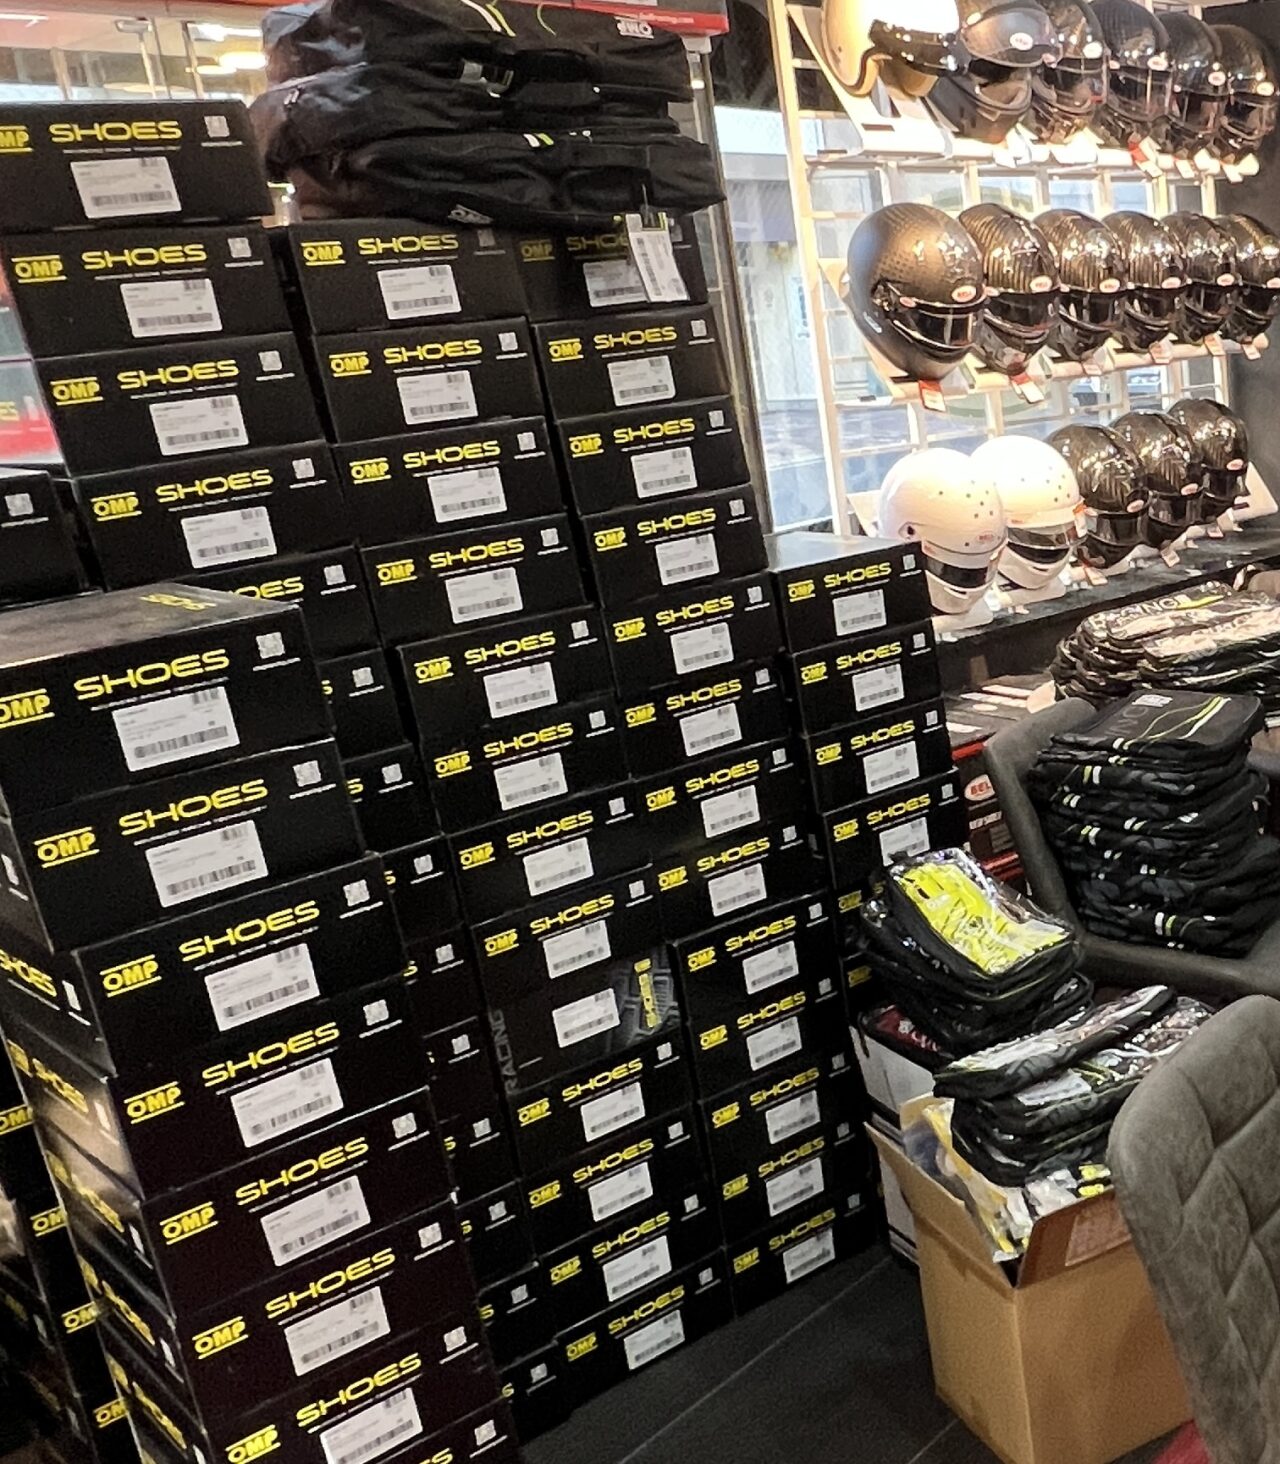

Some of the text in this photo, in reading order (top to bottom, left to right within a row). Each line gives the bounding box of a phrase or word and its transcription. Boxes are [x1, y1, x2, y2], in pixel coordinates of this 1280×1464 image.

[49, 120, 182, 143] SHOES
[303, 244, 343, 263] OMP
[358, 234, 458, 255] SHOES
[566, 235, 630, 251] SHO
[14, 259, 64, 280] OMP
[82, 244, 208, 270] SHOES
[383, 339, 482, 364] SHOES
[550, 340, 582, 359] OMP
[594, 326, 677, 350] SHOES
[117, 360, 240, 390] SHOES
[330, 354, 369, 374] OMP
[53, 380, 100, 402] OMP
[614, 418, 695, 443] SHOES
[403, 441, 500, 468] SHOES
[570, 435, 602, 454] OMP
[351, 461, 388, 481] OMP
[155, 470, 272, 503] SHOES
[94, 495, 139, 518] OMP
[639, 508, 716, 536] SHOES
[596, 529, 626, 548] OMP
[429, 538, 524, 568] SHOES
[377, 562, 415, 583] OMP
[824, 562, 892, 588] SHOES
[229, 576, 304, 600] OES
[788, 582, 814, 600] OMP
[656, 596, 734, 624] SHOES
[614, 620, 645, 639] OMP
[466, 632, 556, 663] SHOES
[837, 643, 900, 670] SHOES
[74, 652, 230, 700] SHOES
[416, 660, 452, 681] OMP
[801, 665, 826, 683] OMP
[666, 680, 742, 710] SHOES
[627, 706, 655, 724] OMP
[484, 723, 573, 757] SHOES
[851, 720, 914, 749] SHOES
[436, 755, 470, 775] OMP
[685, 760, 760, 792] SHOES
[647, 789, 675, 808] OMP
[970, 782, 991, 796] BEL
[119, 780, 268, 836] SHOES
[868, 794, 930, 824] SHOES
[507, 812, 593, 847] SHOES
[36, 832, 96, 863] OMP
[460, 846, 494, 866] OMP
[697, 838, 770, 872] SHOES
[530, 895, 614, 934] SHOES
[180, 902, 320, 962] SHOES
[486, 933, 518, 953] OMP
[725, 916, 796, 951] SHOES
[103, 960, 159, 992] OMP
[738, 992, 806, 1029] SHOES
[202, 1024, 338, 1086] SHOES
[562, 1059, 642, 1100] SHOES
[750, 1068, 819, 1105] SHOES
[126, 1087, 181, 1119] OMP
[235, 1138, 369, 1206] SHOES
[573, 1140, 652, 1182] SHOES
[33, 1212, 66, 1230] OM
[163, 1206, 215, 1240] OMP
[592, 1214, 670, 1258] SHOES
[265, 1250, 396, 1319] SHOES
[63, 1310, 97, 1329] OM
[194, 1321, 246, 1354] OMP
[296, 1354, 422, 1427] SHOES
[96, 1402, 129, 1424] OM
[228, 1426, 278, 1463] OMP
